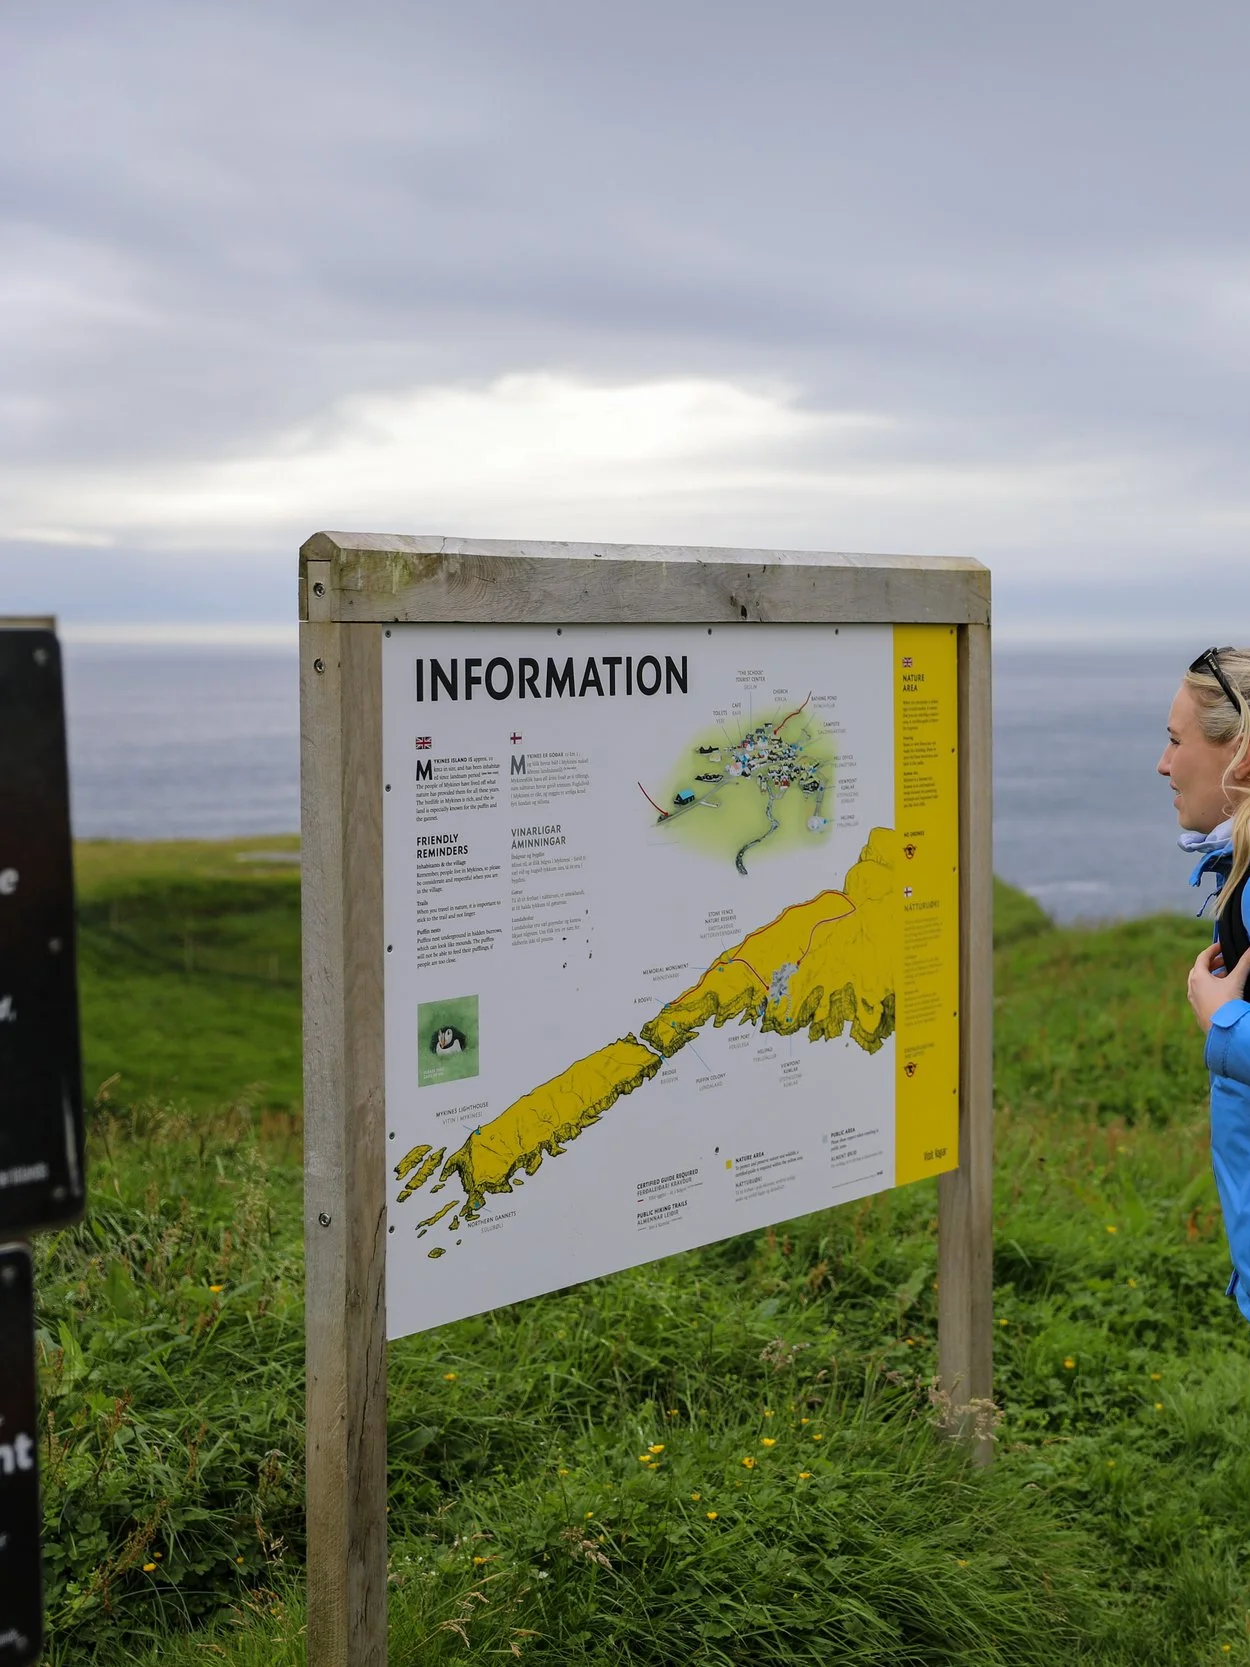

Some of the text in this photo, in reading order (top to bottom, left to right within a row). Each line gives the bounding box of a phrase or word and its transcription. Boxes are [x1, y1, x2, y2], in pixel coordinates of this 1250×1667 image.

[416, 655, 688, 702] INFORMATION
[416, 760, 432, 781] M
[511, 755, 526, 775] M
[417, 834, 458, 846] FRIENDLY
[511, 825, 561, 837] VINARLIGAR
[417, 845, 468, 858] REMINDERS
[736, 1154, 752, 1163] NATURE
[637, 1169, 698, 1190] CERTIFIED GUIDE REQUIRED
[637, 1200, 687, 1219] PUBLIC HIKING TRAILS
[468, 1211, 516, 1228] NORTHERN GANNETS
